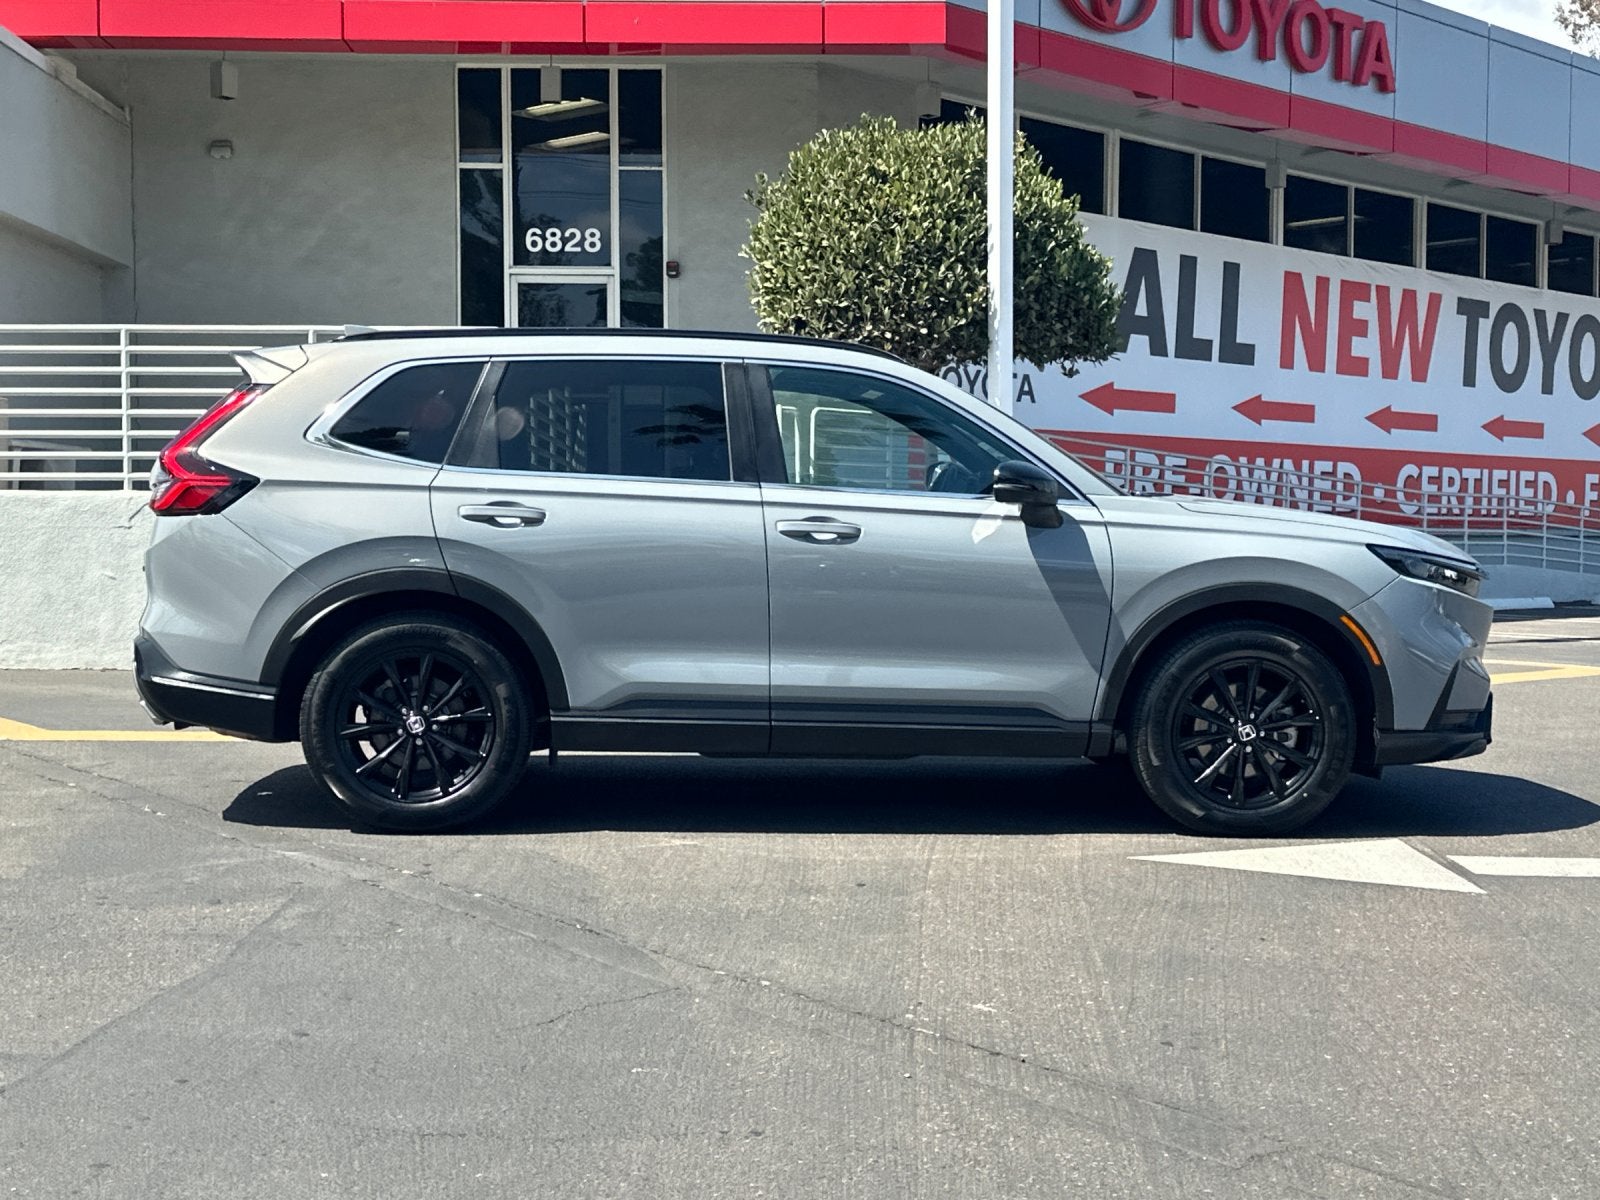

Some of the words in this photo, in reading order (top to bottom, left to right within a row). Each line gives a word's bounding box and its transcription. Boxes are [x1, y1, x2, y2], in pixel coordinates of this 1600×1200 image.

[525, 227, 602, 253] 6828
[1114, 246, 1256, 366] ALL
[1279, 270, 1443, 383] NEW
[1456, 296, 1600, 401] TOYO
[1396, 463, 1558, 517] CERTIFIED
